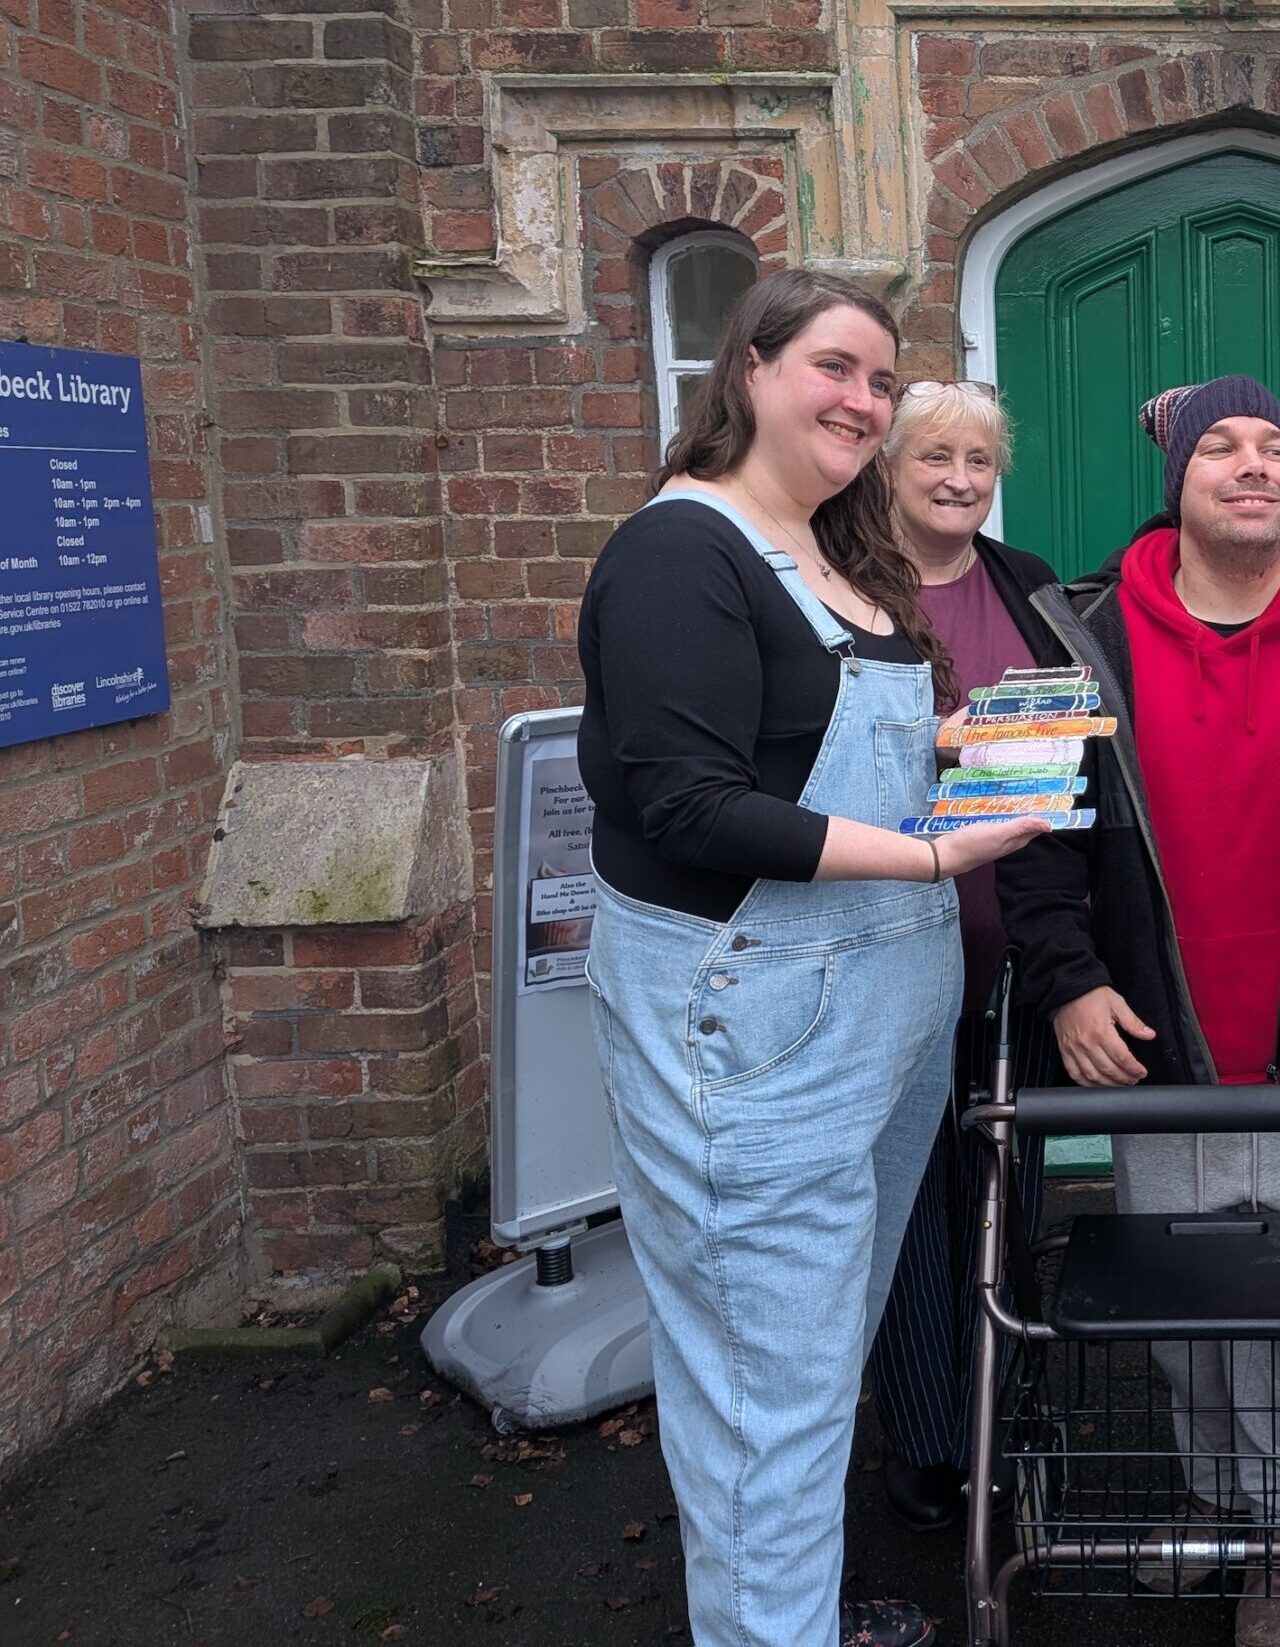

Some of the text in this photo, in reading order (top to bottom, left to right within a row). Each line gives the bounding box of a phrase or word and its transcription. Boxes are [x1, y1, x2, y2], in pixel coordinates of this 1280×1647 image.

[56, 372, 131, 414] Library
[49, 458, 78, 470] Closed
[52, 478, 74, 490] 10am
[80, 478, 97, 491] 1pm
[54, 497, 75, 509] 10am
[82, 497, 98, 511] 1pm
[103, 497, 120, 510] 2pm
[125, 497, 141, 510] 4pm
[55, 516, 77, 528] 10am
[83, 516, 100, 529] 1pm
[57, 535, 84, 547] Closed
[0, 556, 39, 570] of Month
[58, 554, 80, 567] 10am
[86, 553, 107, 566] 12pm
[14, 592, 31, 603] local
[32, 590, 54, 602] library
[55, 587, 81, 599] opening
[103, 584, 123, 595] please
[124, 581, 146, 592] contact
[26, 604, 49, 617] Centre
[50, 604, 60, 614] on
[60, 600, 81, 614] 01522
[82, 598, 106, 611] 782010
[106, 599, 114, 608] or
[114, 598, 122, 609] go
[123, 595, 142, 606] online
[142, 594, 149, 604] at
[96, 671, 138, 688] Lincolnshire
[51, 680, 85, 697] discover
[51, 692, 86, 709] libraries
[985, 712, 1058, 724] PERSUASION
[966, 729, 985, 742] The
[540, 783, 584, 795] Pinchbeck
[953, 777, 1040, 797] MATILDA
[553, 796, 569, 805] For
[570, 796, 585, 804] our
[968, 796, 1038, 814] EMMA
[542, 807, 561, 818] Join
[562, 808, 573, 816] us
[574, 805, 587, 815] for
[548, 829, 561, 839] All
[560, 880, 586, 890] Also the
[541, 892, 559, 900] Hand
[570, 888, 590, 897] Down
[551, 907, 567, 916] shop
[568, 905, 580, 913] will
